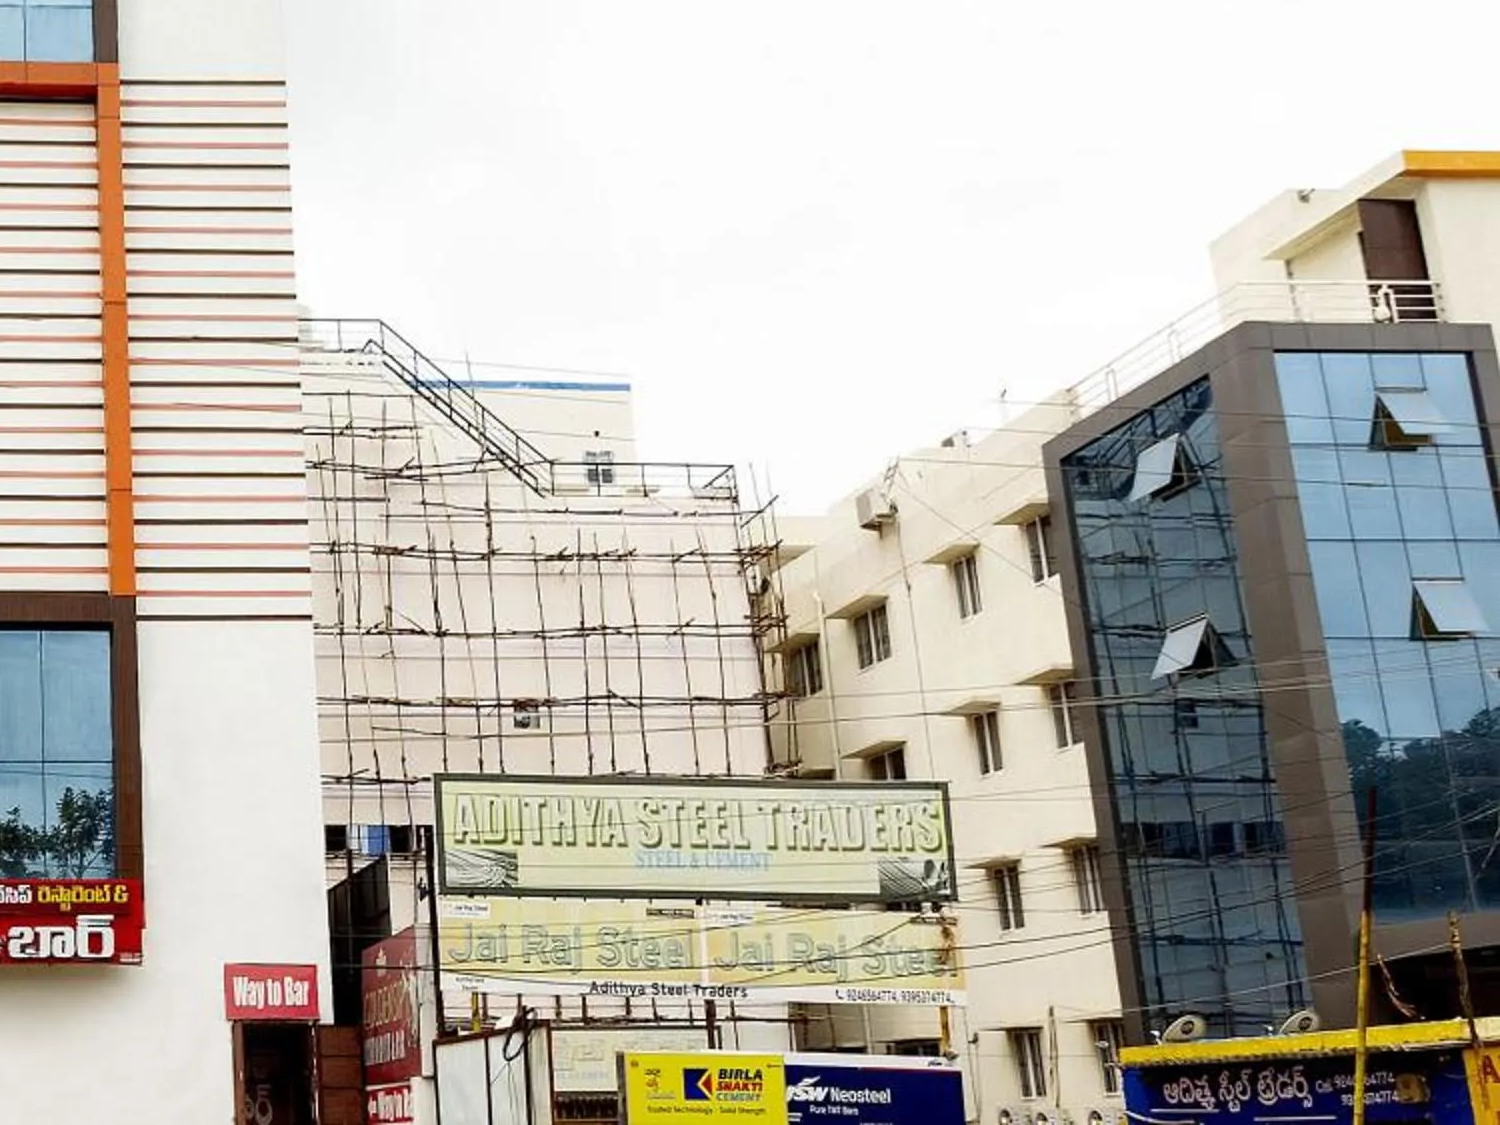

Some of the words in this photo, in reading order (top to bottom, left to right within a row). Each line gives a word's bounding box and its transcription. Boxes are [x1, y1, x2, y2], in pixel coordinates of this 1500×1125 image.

[454, 794, 628, 848] ADITHYA
[637, 798, 751, 850] STEEL
[757, 799, 944, 853] TRADERS
[635, 851, 682, 869] STEEL
[705, 852, 773, 872] CEMENT
[7, 914, 115, 958] బార్
[449, 924, 508, 964] Jai
[522, 925, 581, 975] Raj
[596, 926, 694, 969] Steel
[713, 931, 774, 972] Jai
[786, 932, 848, 981] Raj
[862, 934, 959, 977] Steel
[233, 976, 265, 1009] Way
[267, 978, 281, 1005] to
[284, 976, 309, 1006] Bar
[589, 981, 645, 996] Adithya
[651, 982, 688, 996] Steel
[692, 984, 748, 998] Traders
[718, 1068, 763, 1080] BIRLA
[716, 1079, 763, 1091] SHAKTI
[830, 1087, 892, 1104] Neosteel
[716, 1092, 761, 1101] CEMENT
